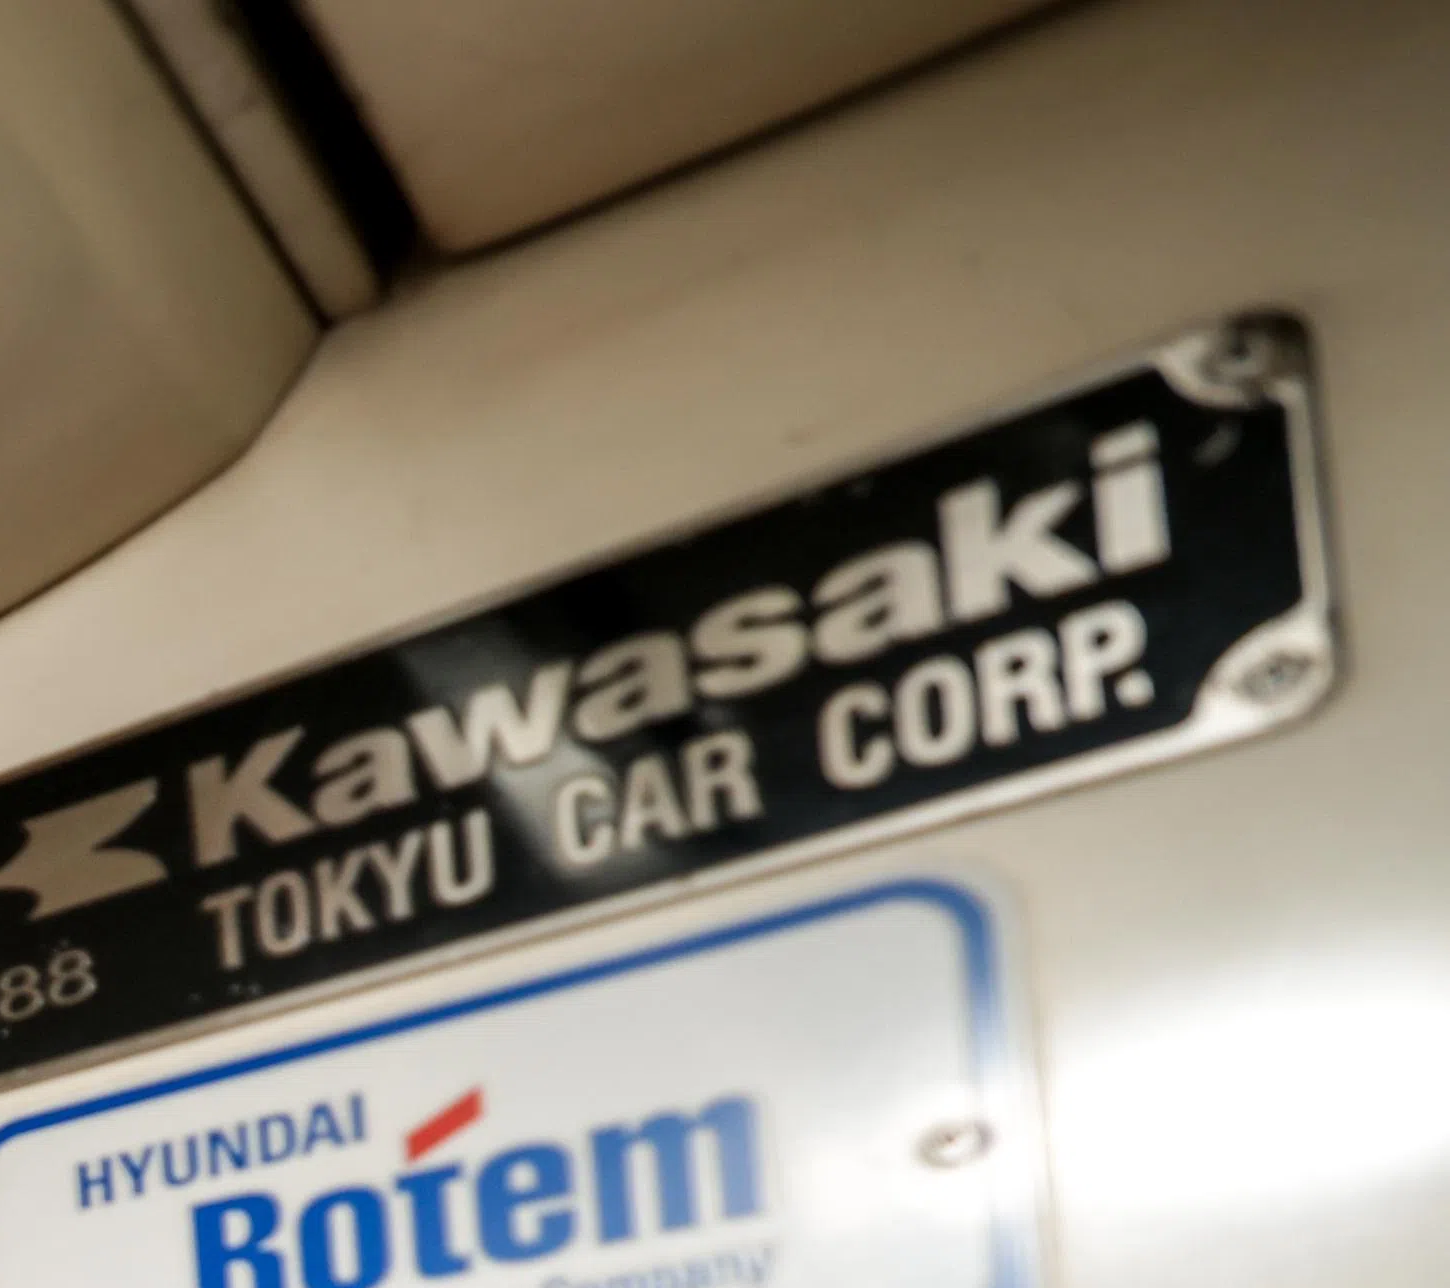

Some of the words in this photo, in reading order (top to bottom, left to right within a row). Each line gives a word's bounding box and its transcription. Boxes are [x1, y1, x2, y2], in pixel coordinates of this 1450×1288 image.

[194, 427, 1168, 861] Kawasaki
[208, 811, 491, 965] TOKYU
[552, 736, 759, 870] CAR
[822, 603, 1153, 786] CORP.
[78, 1096, 364, 1208] HYUNDAI
